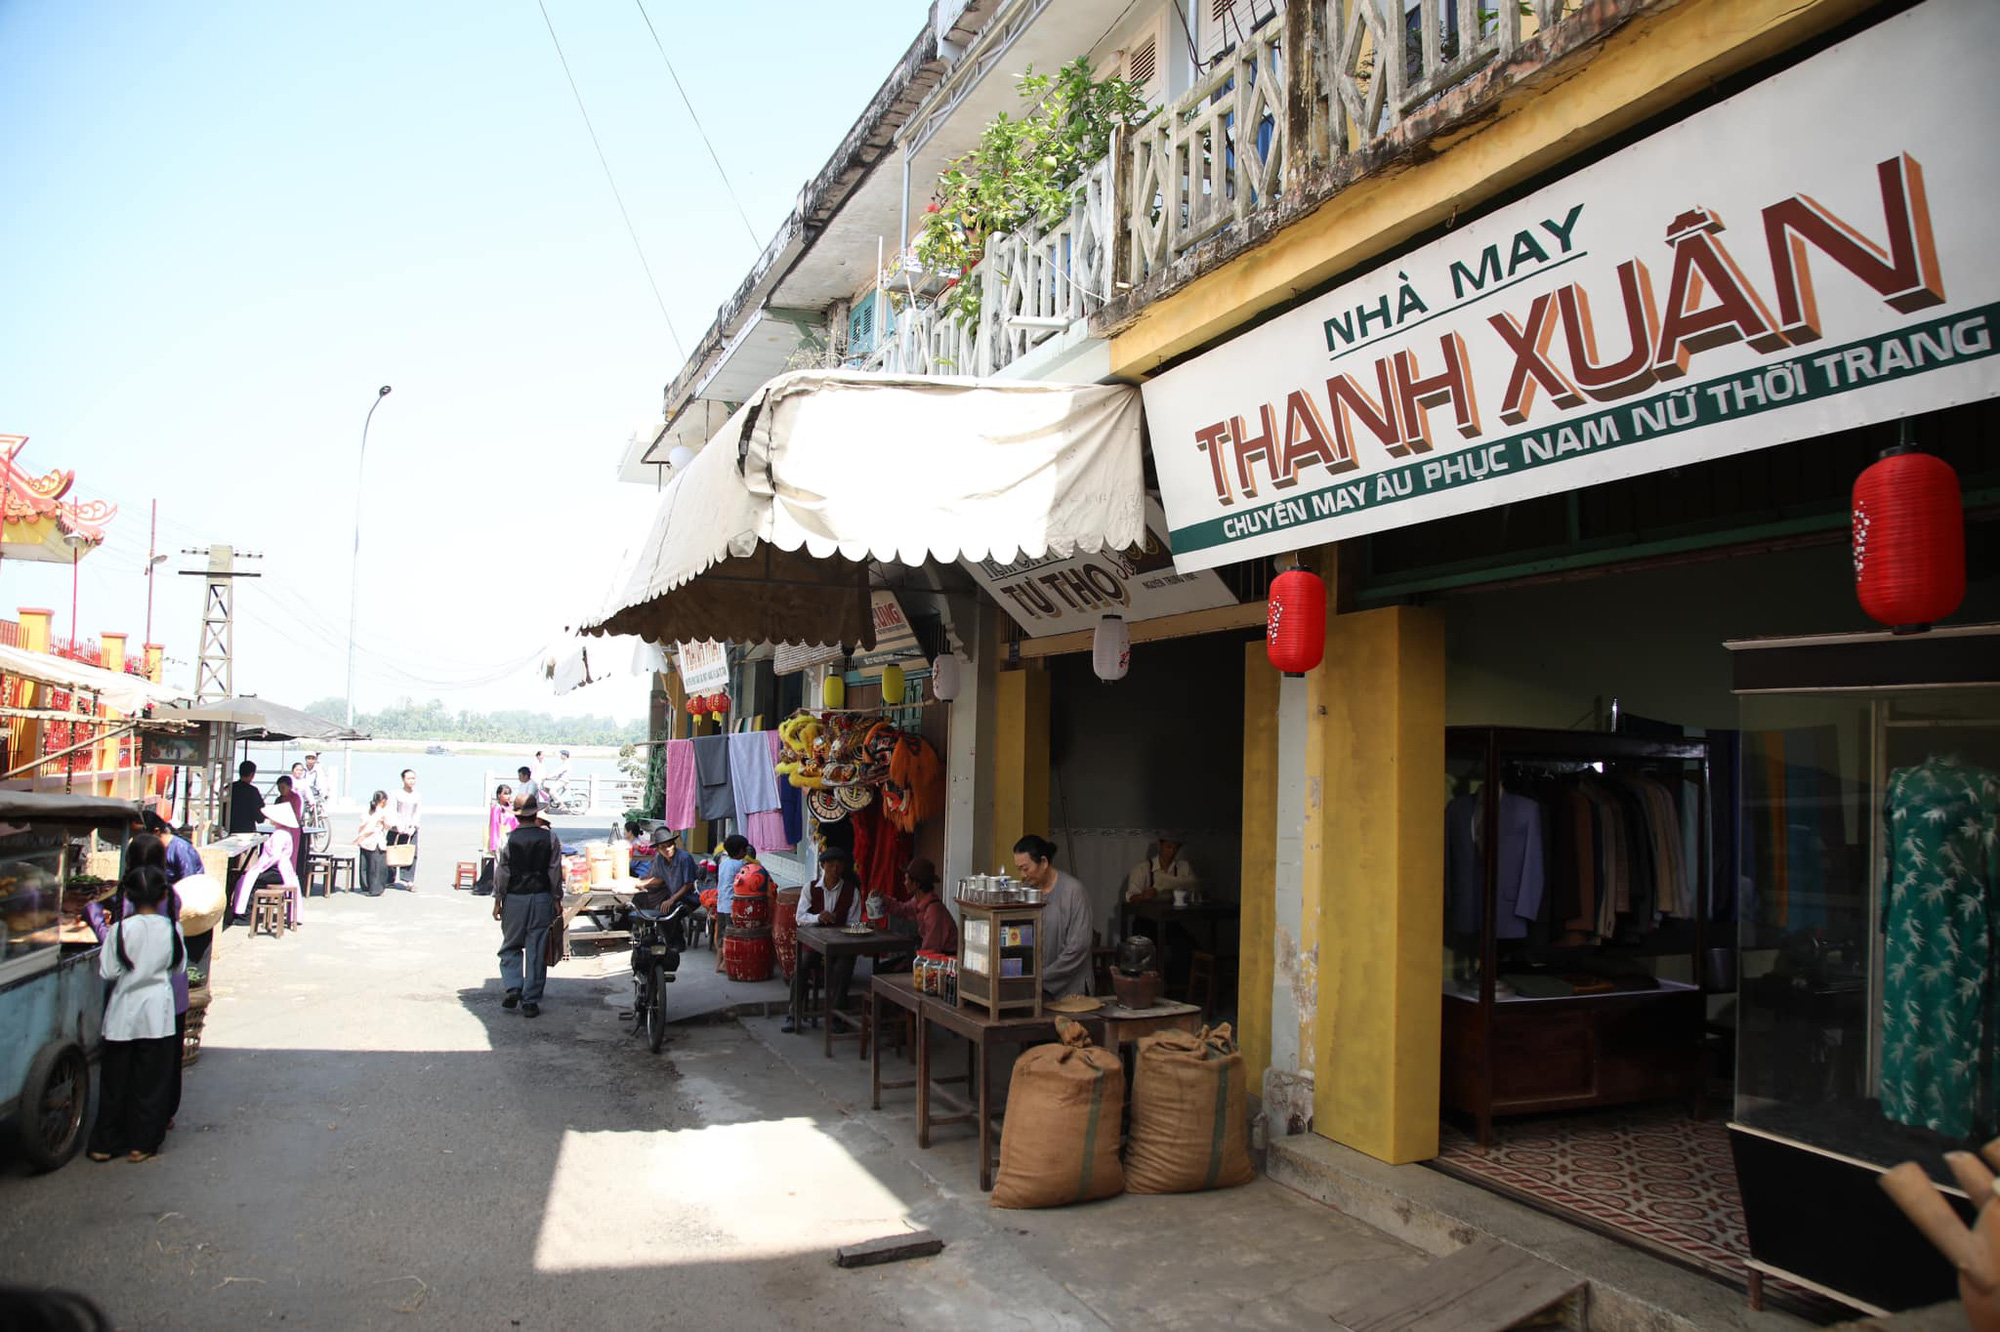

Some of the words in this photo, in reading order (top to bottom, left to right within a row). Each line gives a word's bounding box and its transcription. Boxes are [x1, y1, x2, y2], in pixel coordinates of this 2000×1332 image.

[1194, 330, 1483, 506] THANH
[1487, 149, 1947, 426] XUÂN
[1323, 270, 1429, 352] NHÀ
[1449, 202, 1585, 300] MAY
[1223, 501, 1308, 540] CHUYÊN
[1312, 482, 1368, 518] MAY
[1375, 467, 1414, 502] ÂU
[1422, 443, 1510, 482] PHỤC
[1520, 412, 1620, 464] NAM
[1631, 387, 1700, 437] NỮ
[1706, 357, 1808, 416] THỜI
[1813, 314, 1992, 390] TRANG
[1038, 563, 1130, 612] THỌ
